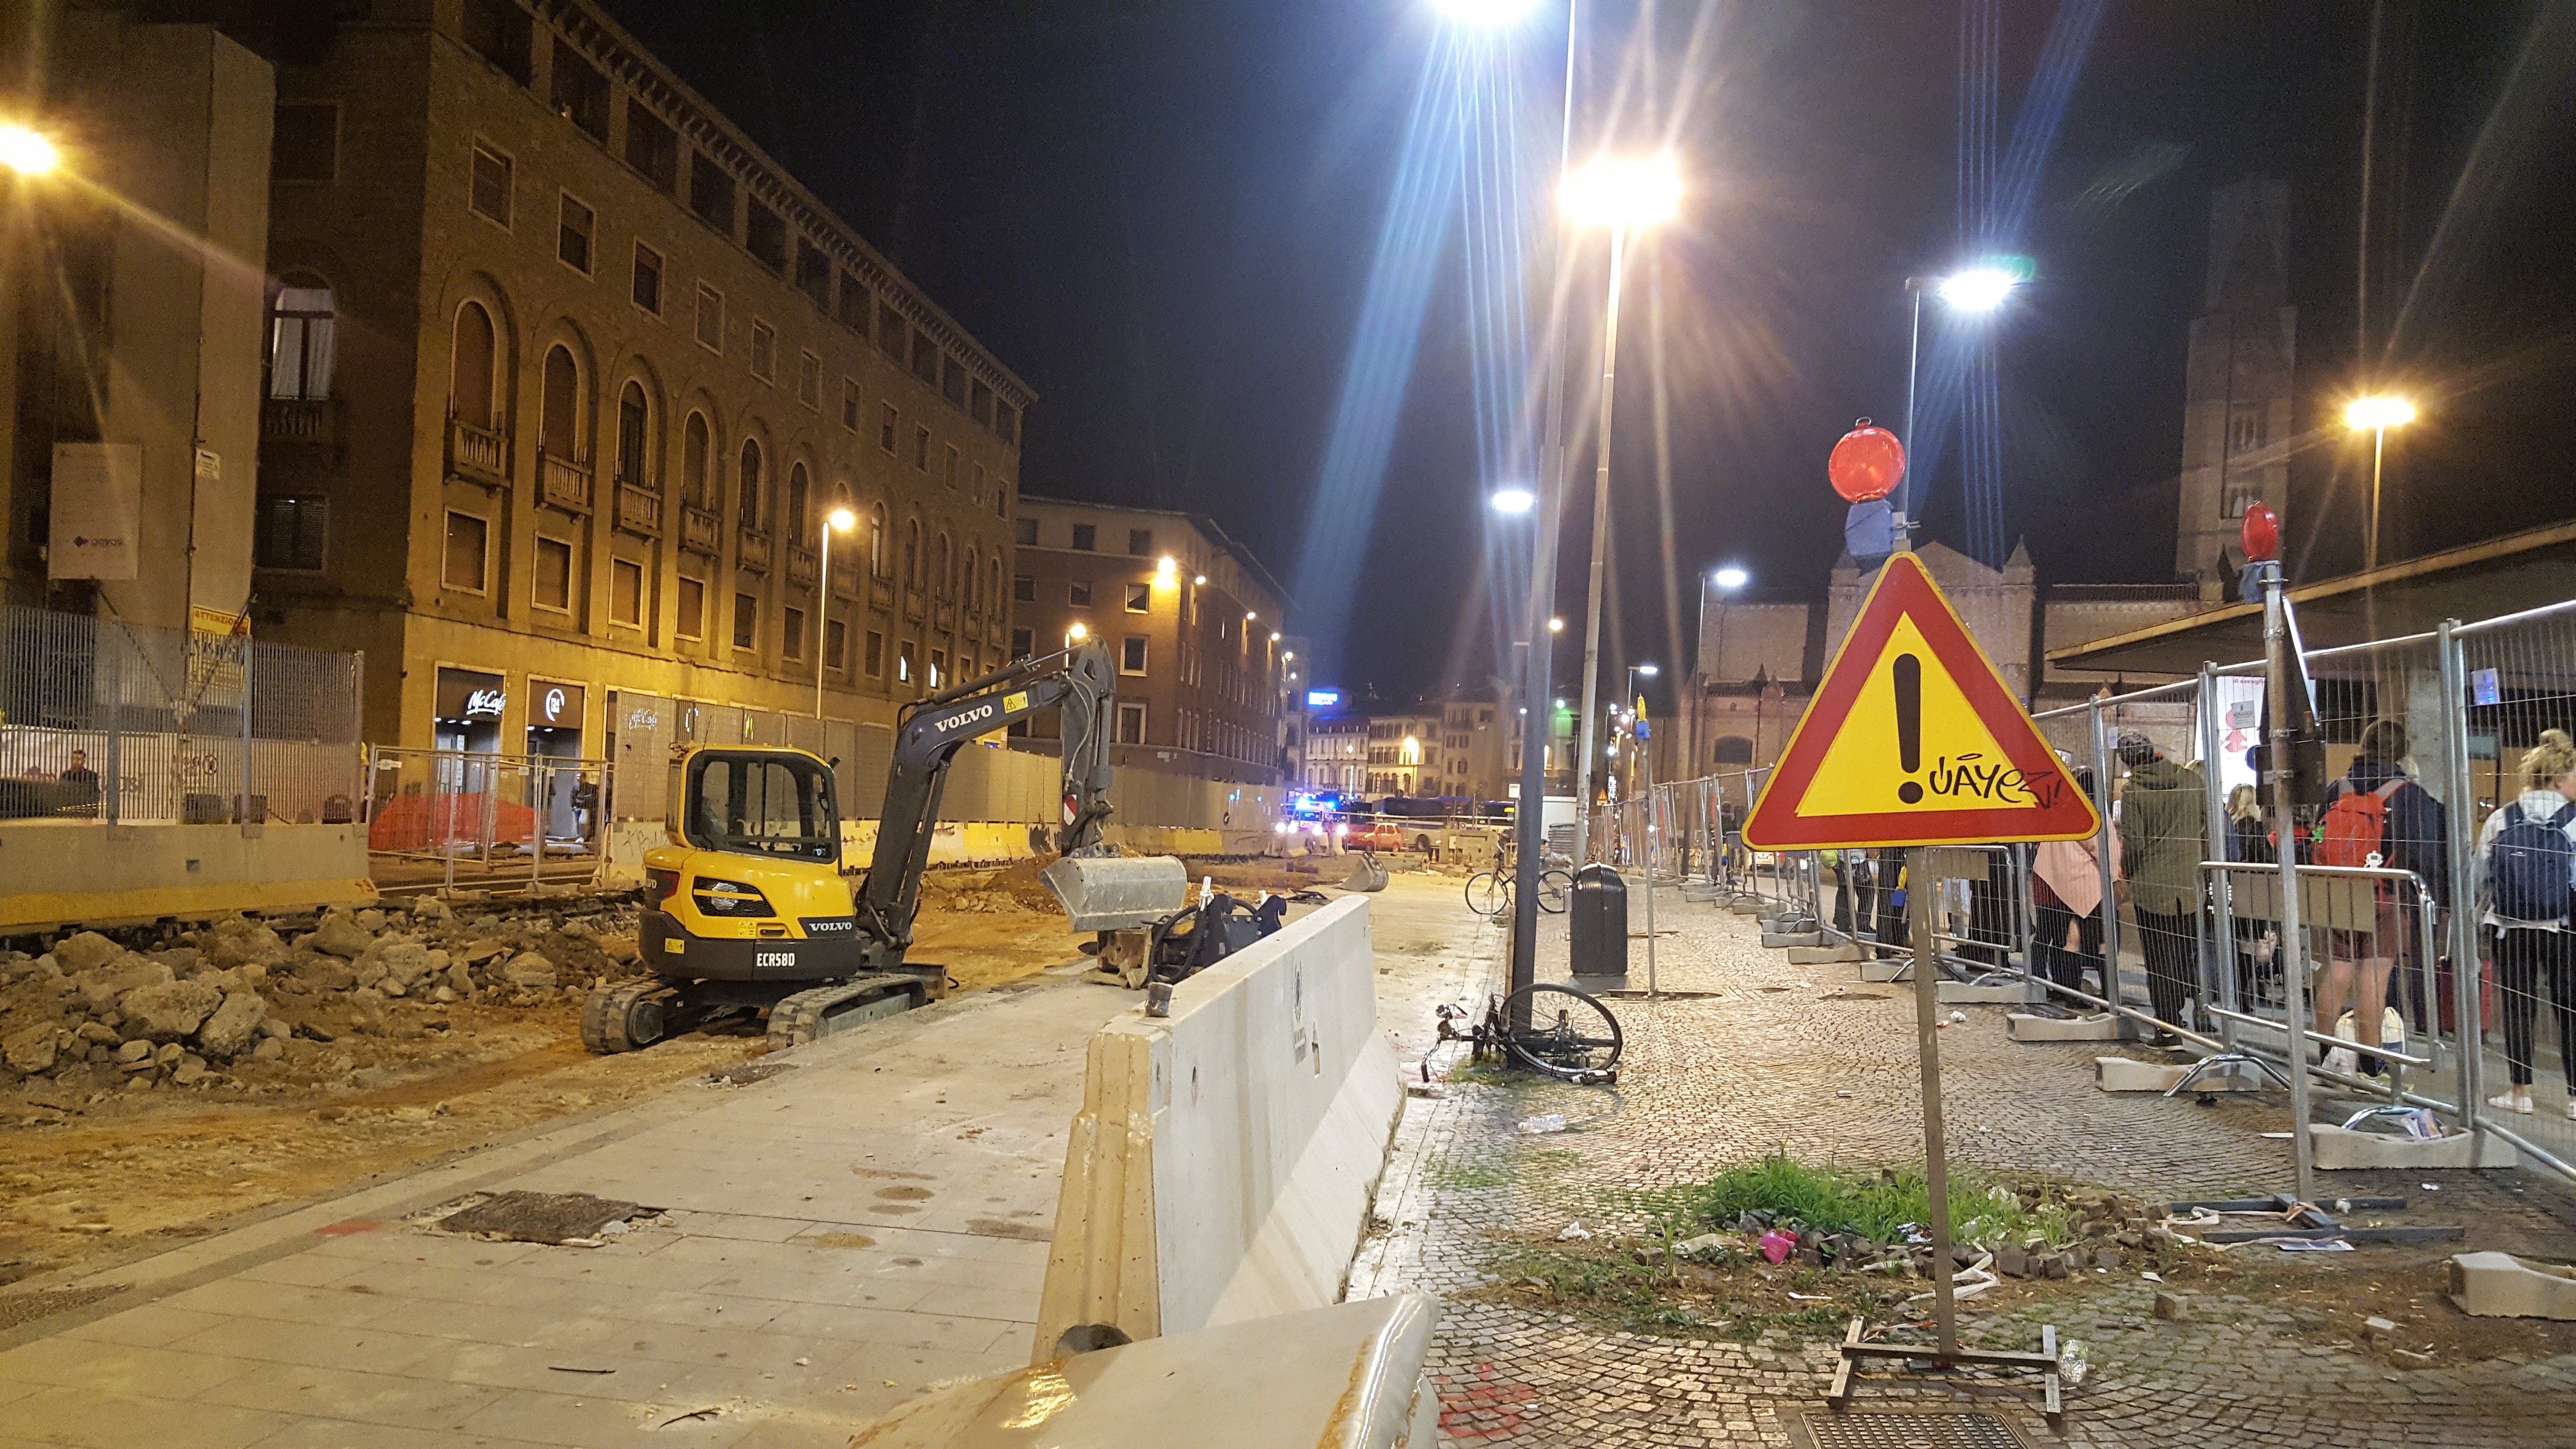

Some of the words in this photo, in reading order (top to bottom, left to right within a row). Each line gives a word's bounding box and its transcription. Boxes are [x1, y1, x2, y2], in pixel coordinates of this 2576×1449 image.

[467, 690, 506, 715] McCafé
[934, 705, 993, 732] VOLVO
[809, 922, 852, 931] VOLVO
[757, 952, 795, 966] ECR58D
